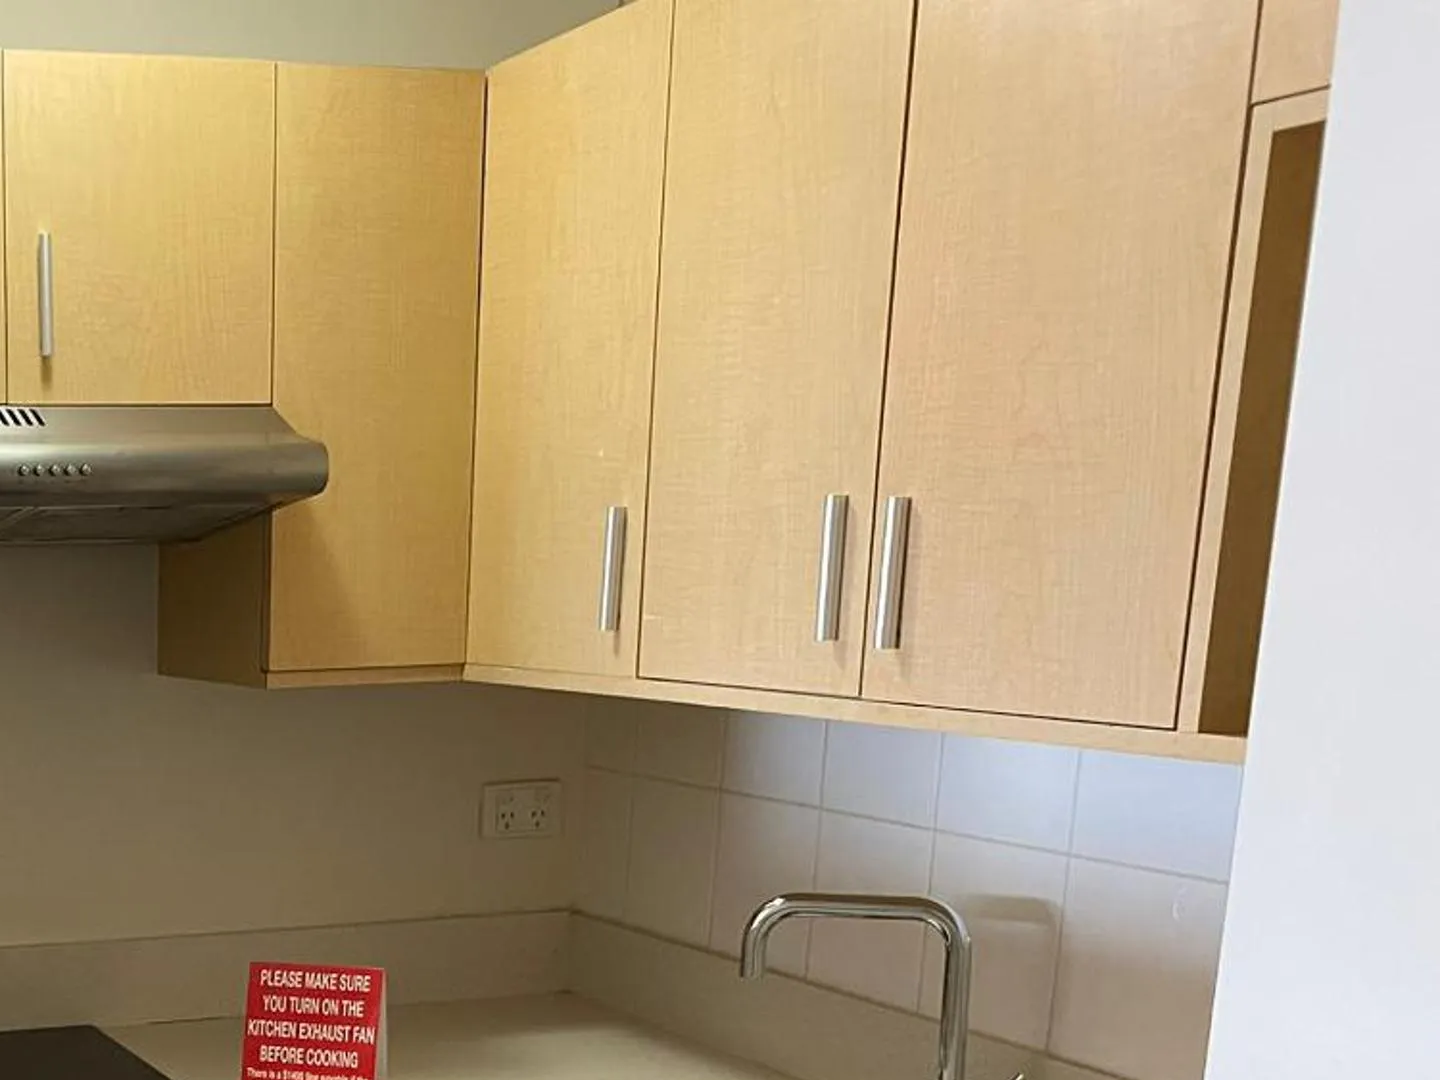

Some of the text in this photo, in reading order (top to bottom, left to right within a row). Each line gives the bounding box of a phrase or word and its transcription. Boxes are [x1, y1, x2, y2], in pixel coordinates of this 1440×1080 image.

[260, 969, 371, 992] PLEASE MAKE SURE
[263, 995, 364, 1018] YOU TURN ON THE
[247, 1019, 375, 1045] KITCHEN EXHAUST FAN
[260, 1045, 358, 1068] BEFORE COOKING
